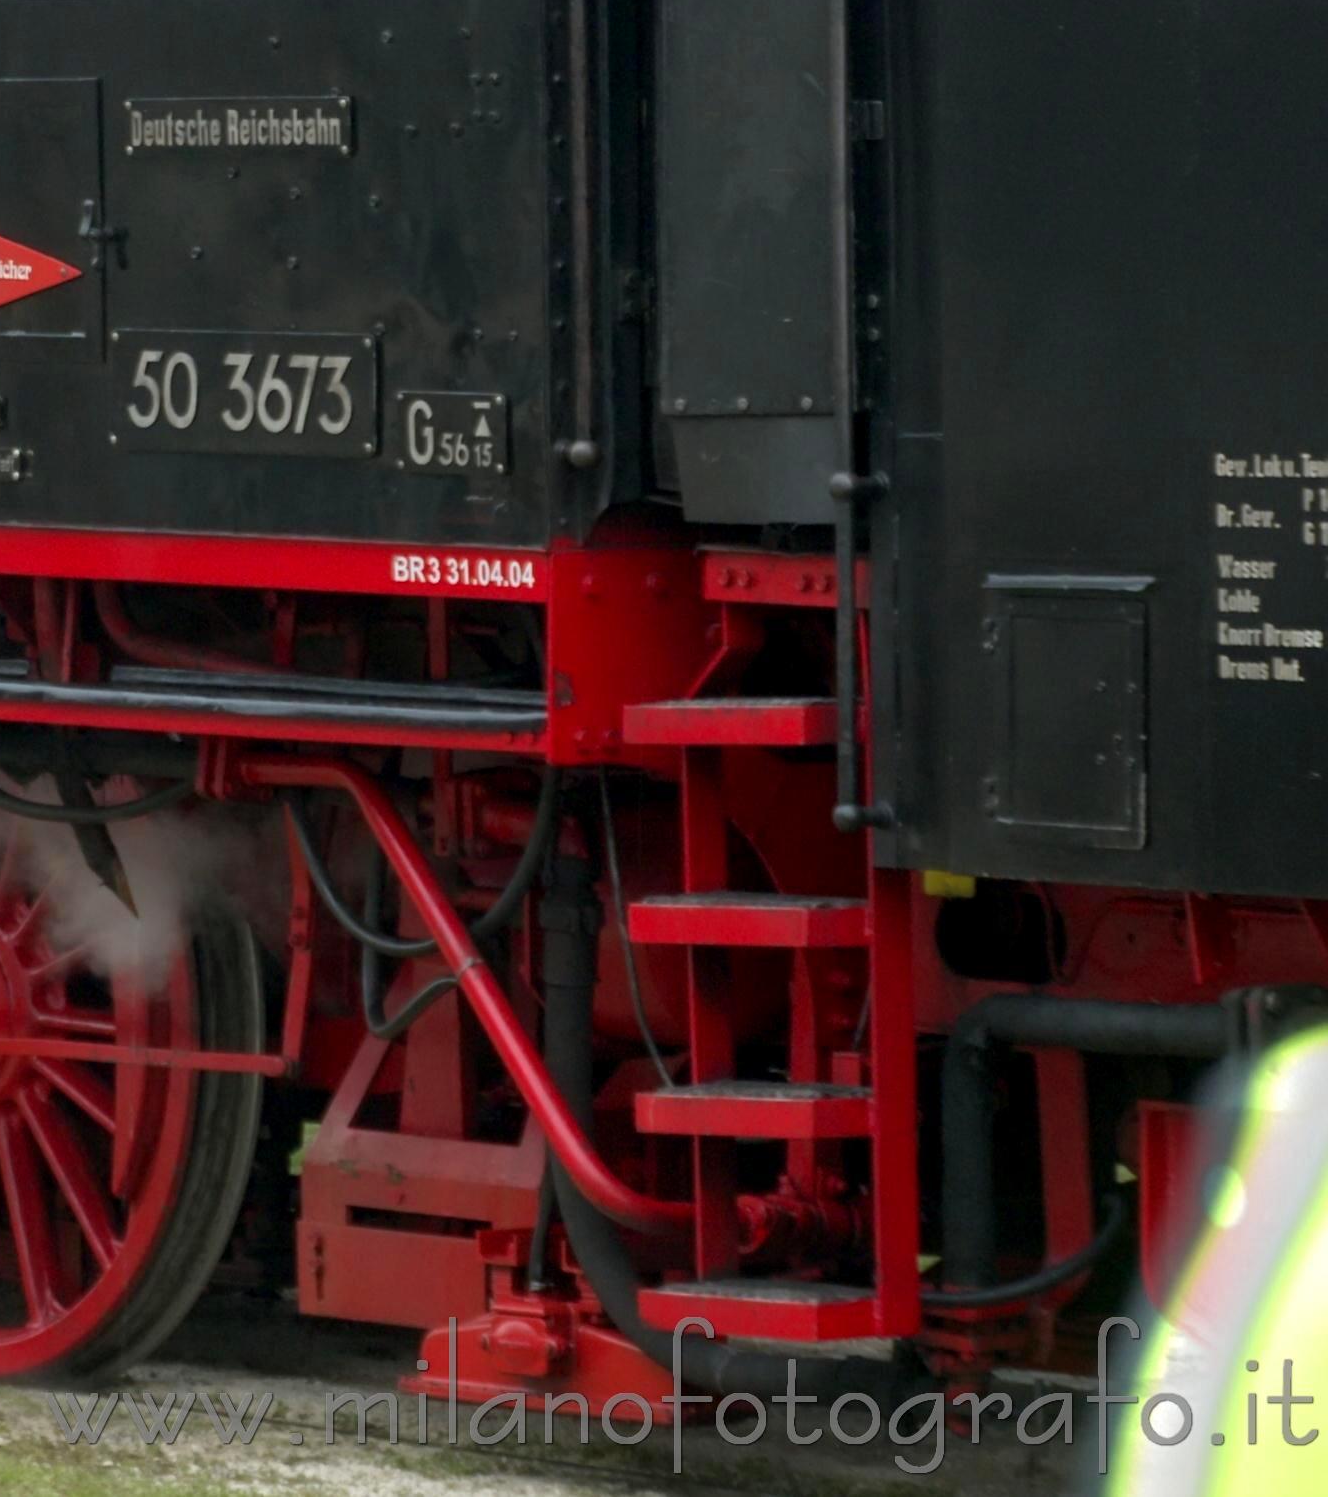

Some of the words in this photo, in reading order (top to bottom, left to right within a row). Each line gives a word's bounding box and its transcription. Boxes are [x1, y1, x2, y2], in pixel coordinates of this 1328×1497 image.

[131, 110, 220, 147] Deutsche
[227, 109, 341, 145] Reichsbahn
[127, 350, 198, 430] 50
[222, 352, 353, 435] 3673
[407, 399, 434, 466] G
[438, 433, 470, 467] 56
[473, 443, 493, 468] 15
[446, 558, 535, 589] 31.04.04
[1218, 554, 1276, 579] Wasser
